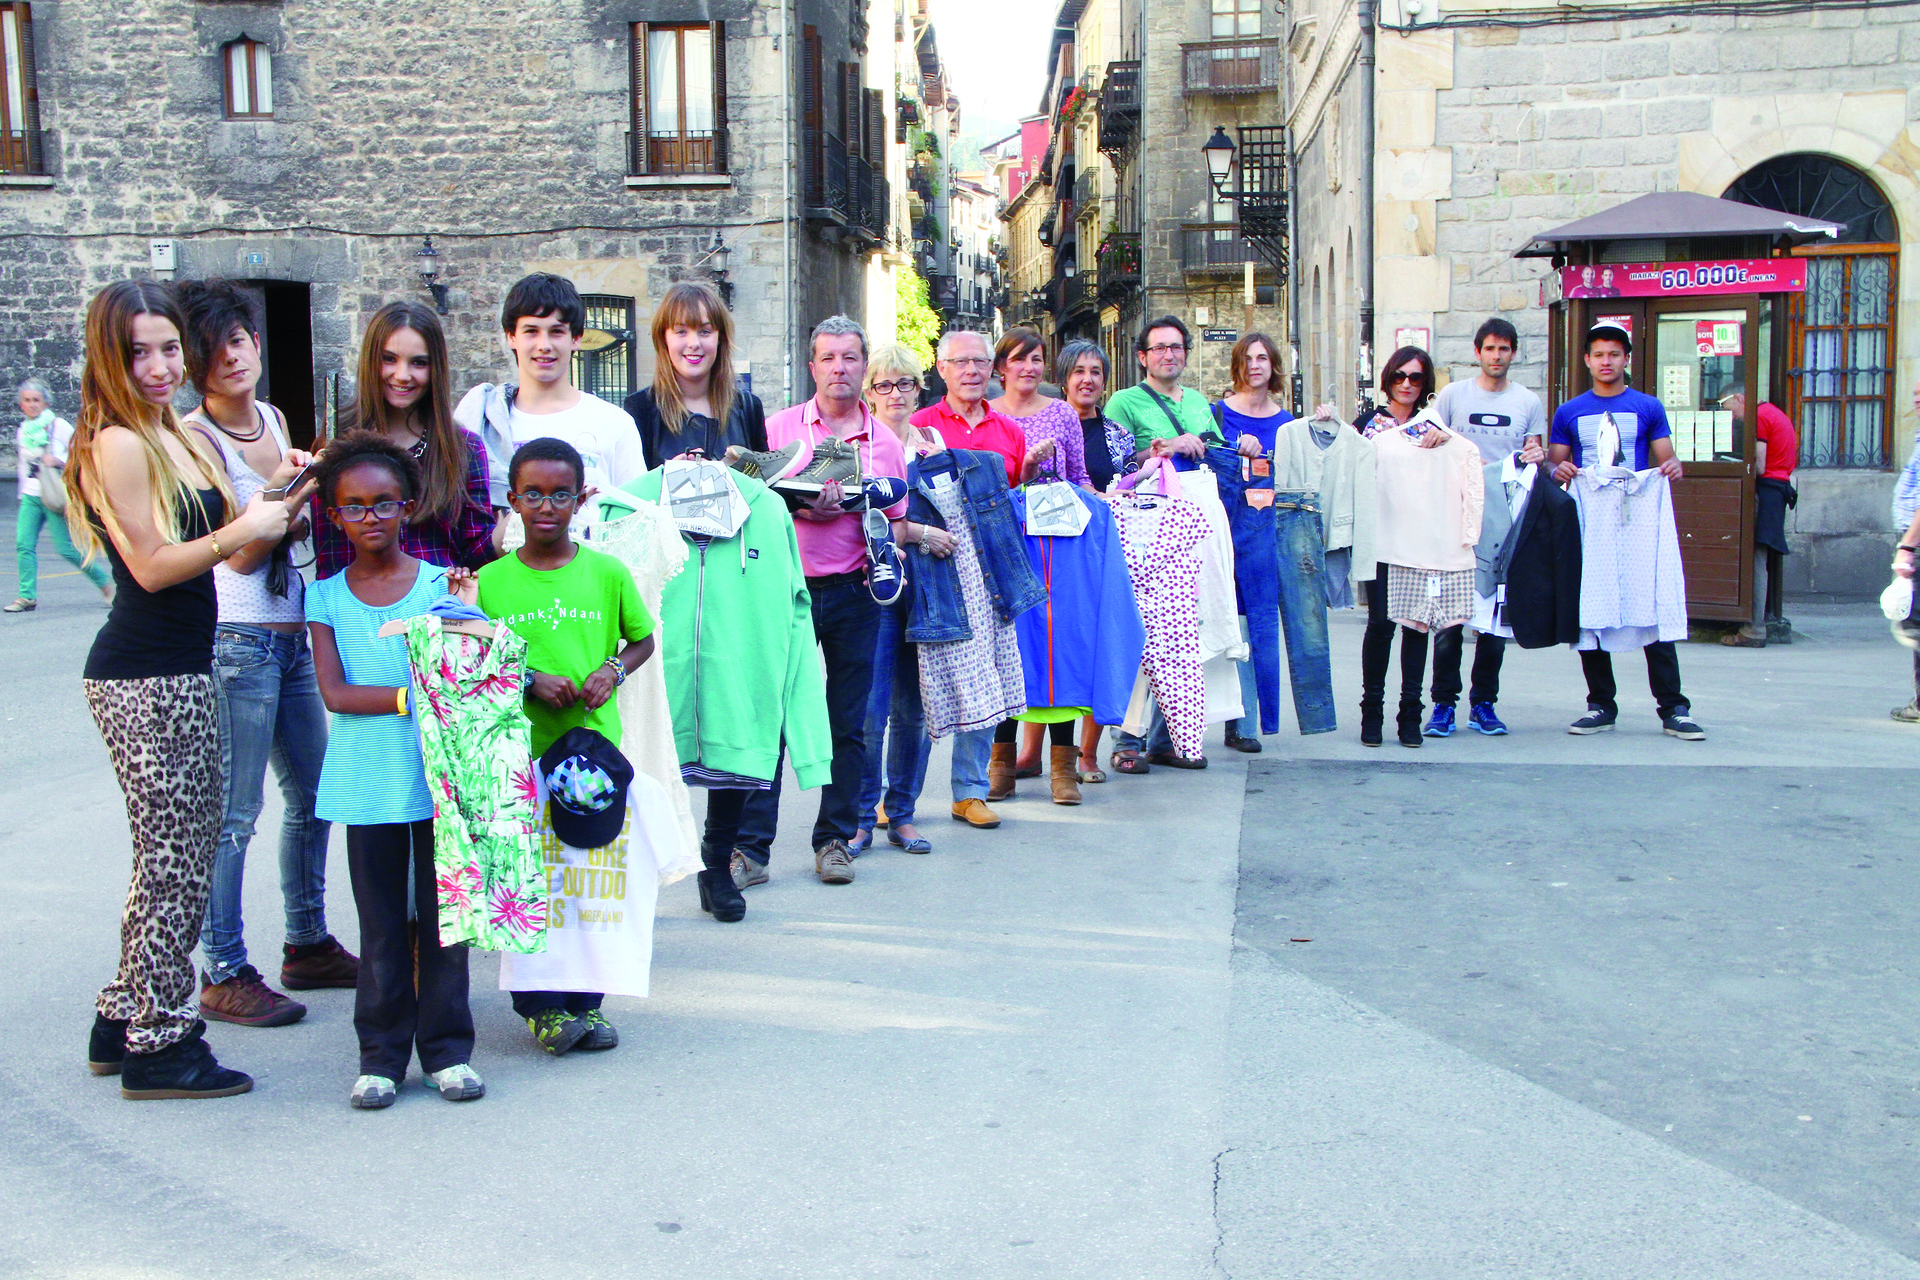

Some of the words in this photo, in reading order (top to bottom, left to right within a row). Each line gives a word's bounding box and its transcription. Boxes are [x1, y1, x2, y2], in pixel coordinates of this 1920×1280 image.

[252, 254, 259, 263] 2
[1630, 271, 1660, 280] IRABAZI
[1661, 265, 1748, 289] 60.000€
[1749, 273, 1776, 282] UNEAN
[1457, 426, 1520, 438] OAKLEY
[1253, 493, 1264, 501] 501
[690, 523, 722, 535] KIROLAK
[541, 833, 566, 864] HE
[563, 866, 627, 901] OUTDO
[579, 908, 623, 923] MBERLAND
